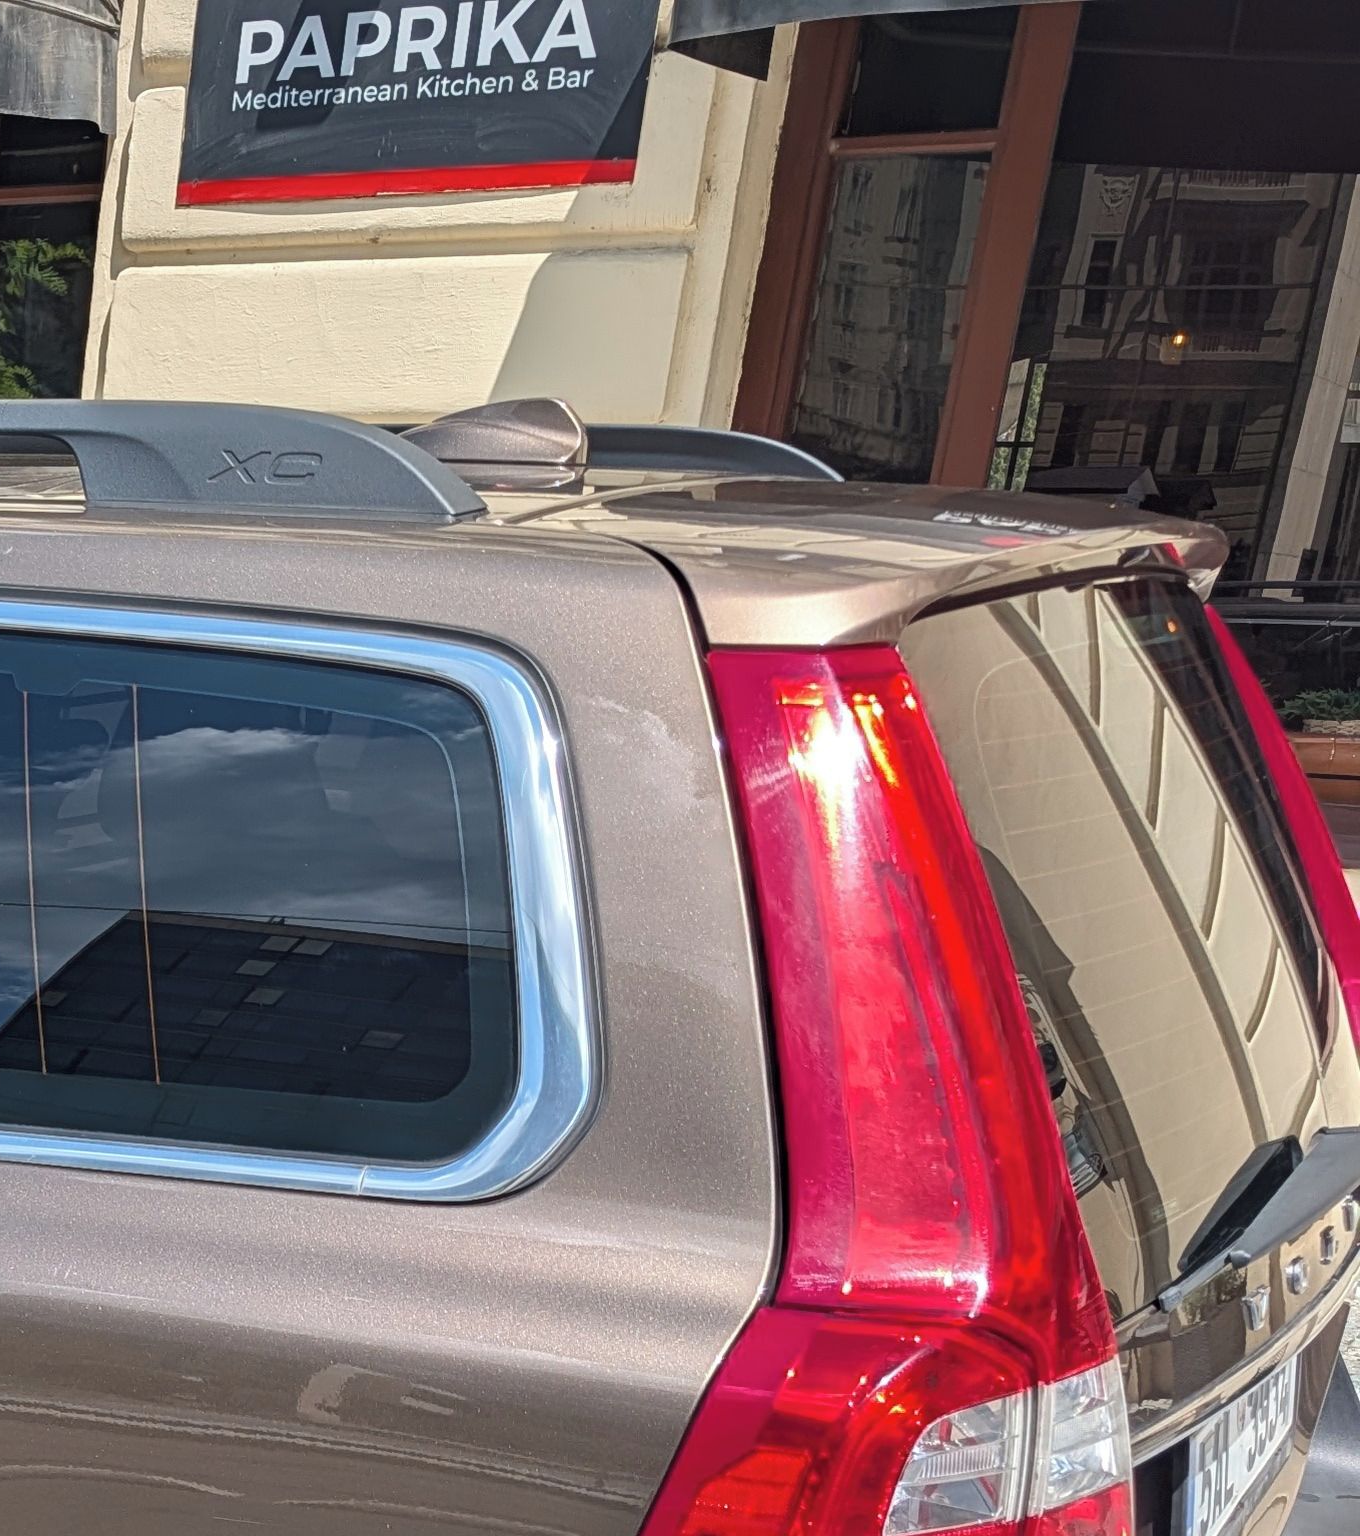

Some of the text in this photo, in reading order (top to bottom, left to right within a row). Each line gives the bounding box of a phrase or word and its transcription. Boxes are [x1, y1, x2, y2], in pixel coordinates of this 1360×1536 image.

[234, 0, 597, 85] PAPRIKA
[232, 66, 595, 112] Mediterranean Kitchen & Bar
[206, 450, 324, 485] XC
